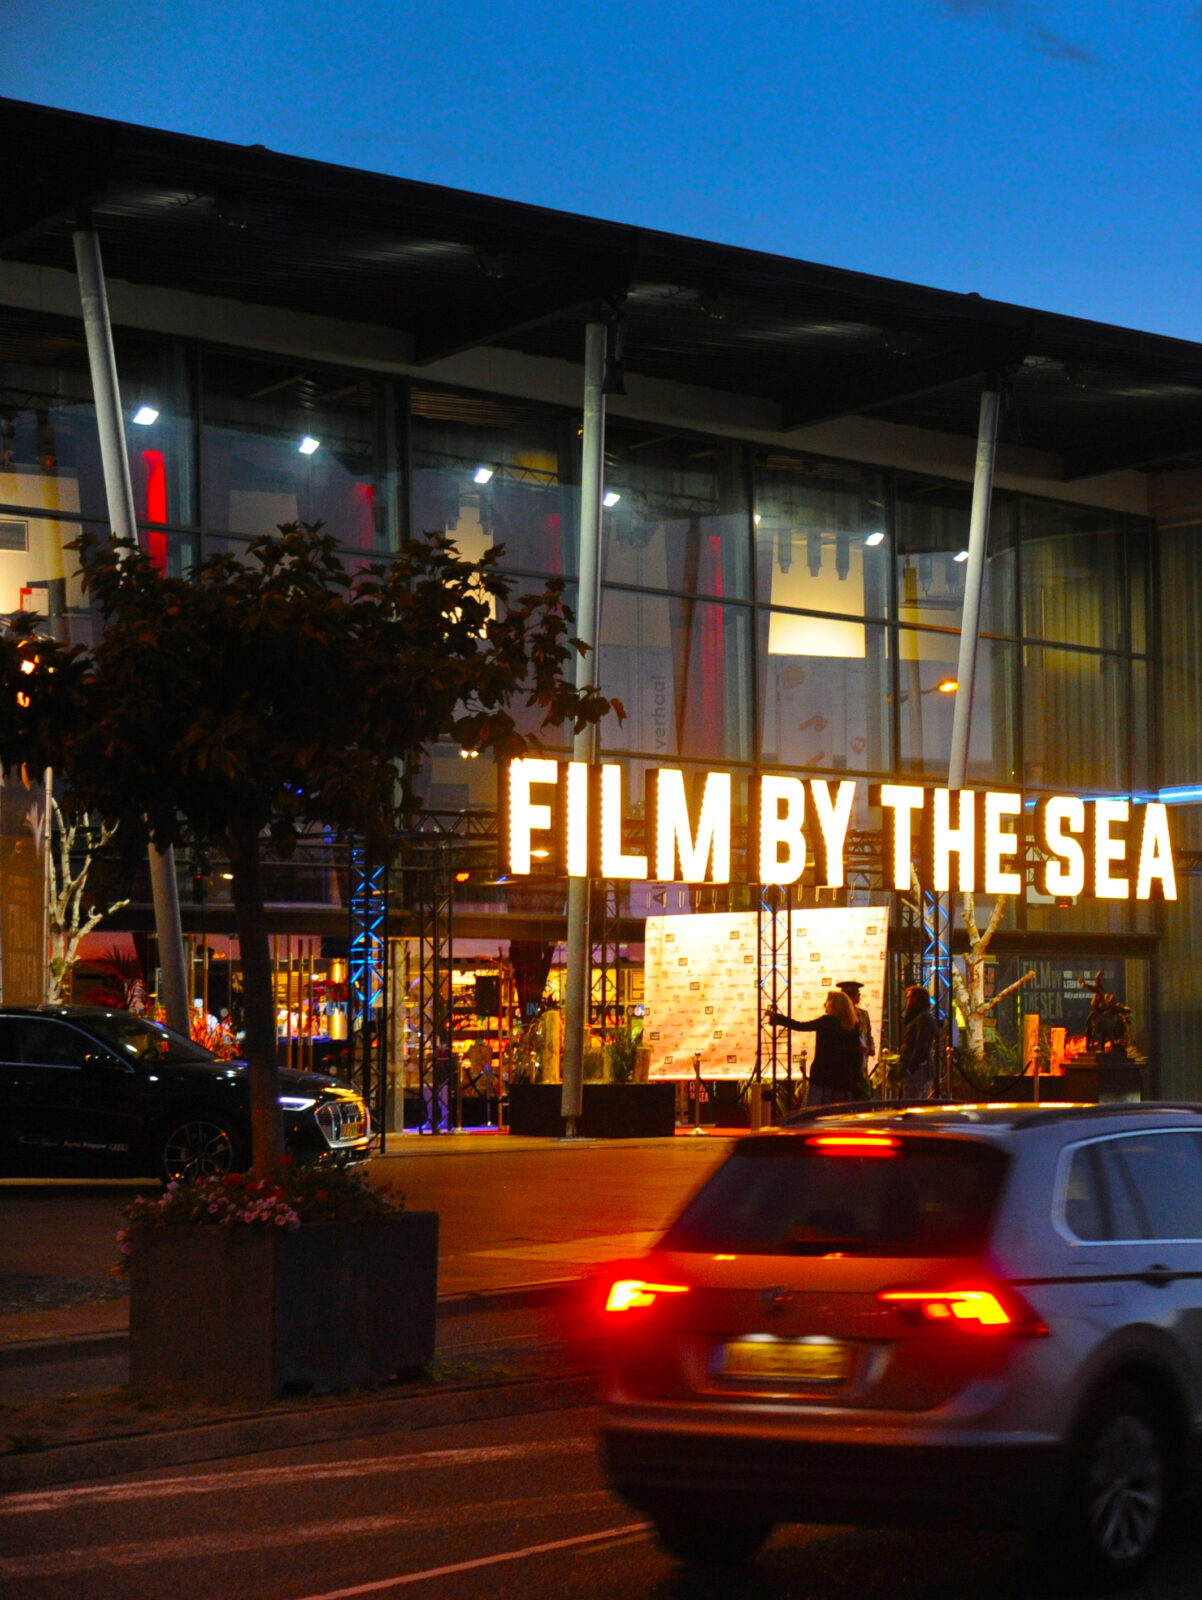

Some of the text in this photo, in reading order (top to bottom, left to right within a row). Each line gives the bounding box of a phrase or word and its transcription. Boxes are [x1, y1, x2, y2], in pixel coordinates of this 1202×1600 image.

[508, 757, 1178, 900] FILM BY THE SEA
[526, 1002, 539, 1016] IN
